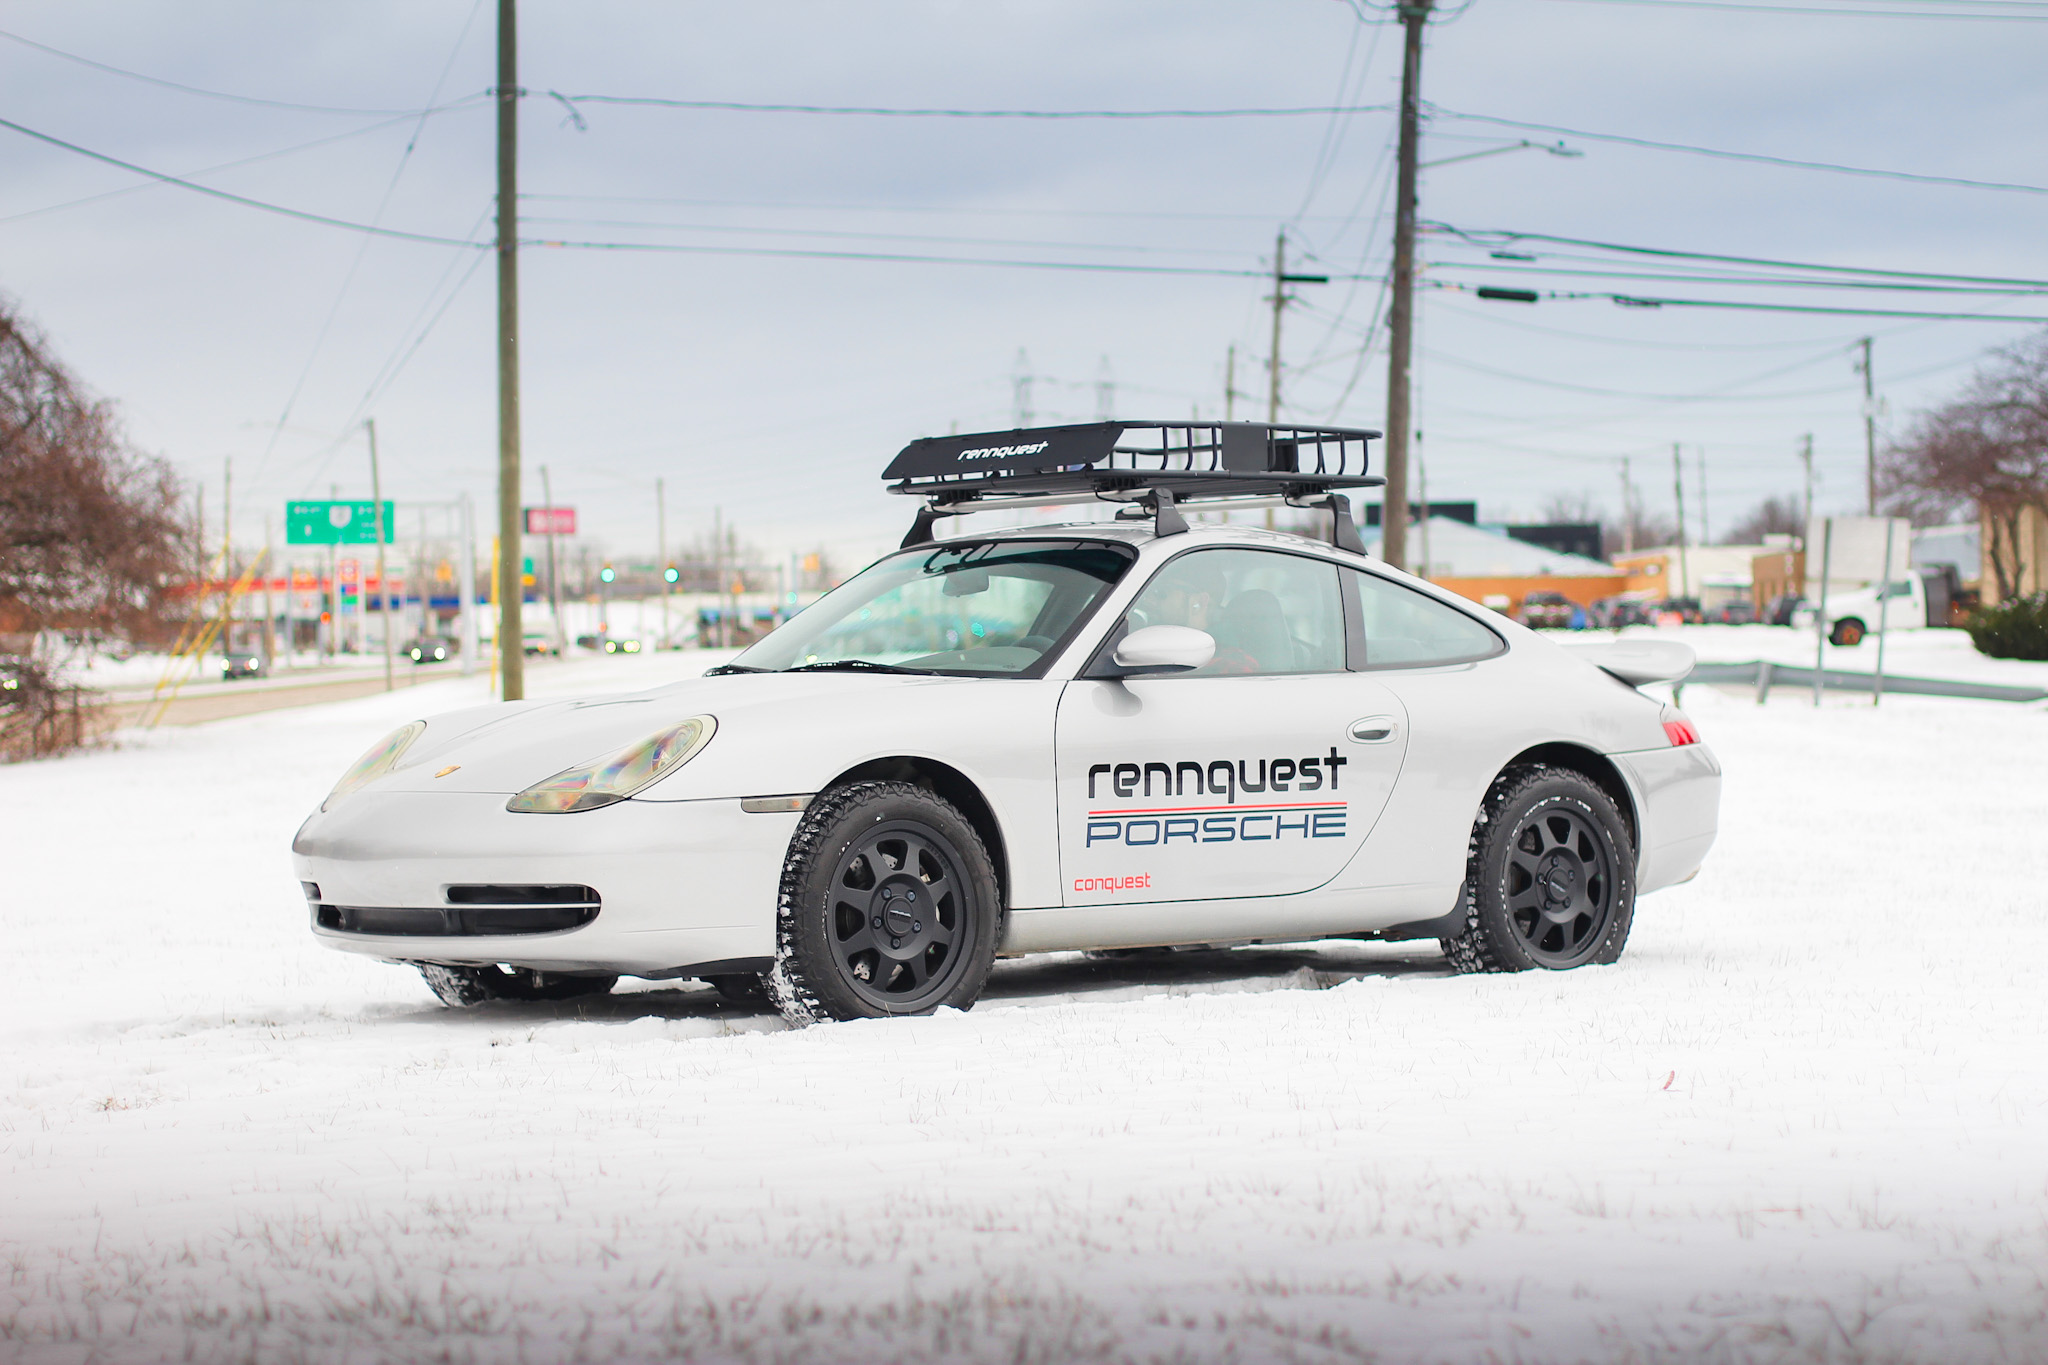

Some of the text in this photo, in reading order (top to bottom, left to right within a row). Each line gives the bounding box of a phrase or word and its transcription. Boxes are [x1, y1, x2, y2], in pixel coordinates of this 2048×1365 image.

[957, 440, 1049, 461] rennquest
[1088, 747, 1348, 804] rennquest
[1086, 812, 1347, 848] PORSCHE
[1074, 871, 1151, 895] conquest
